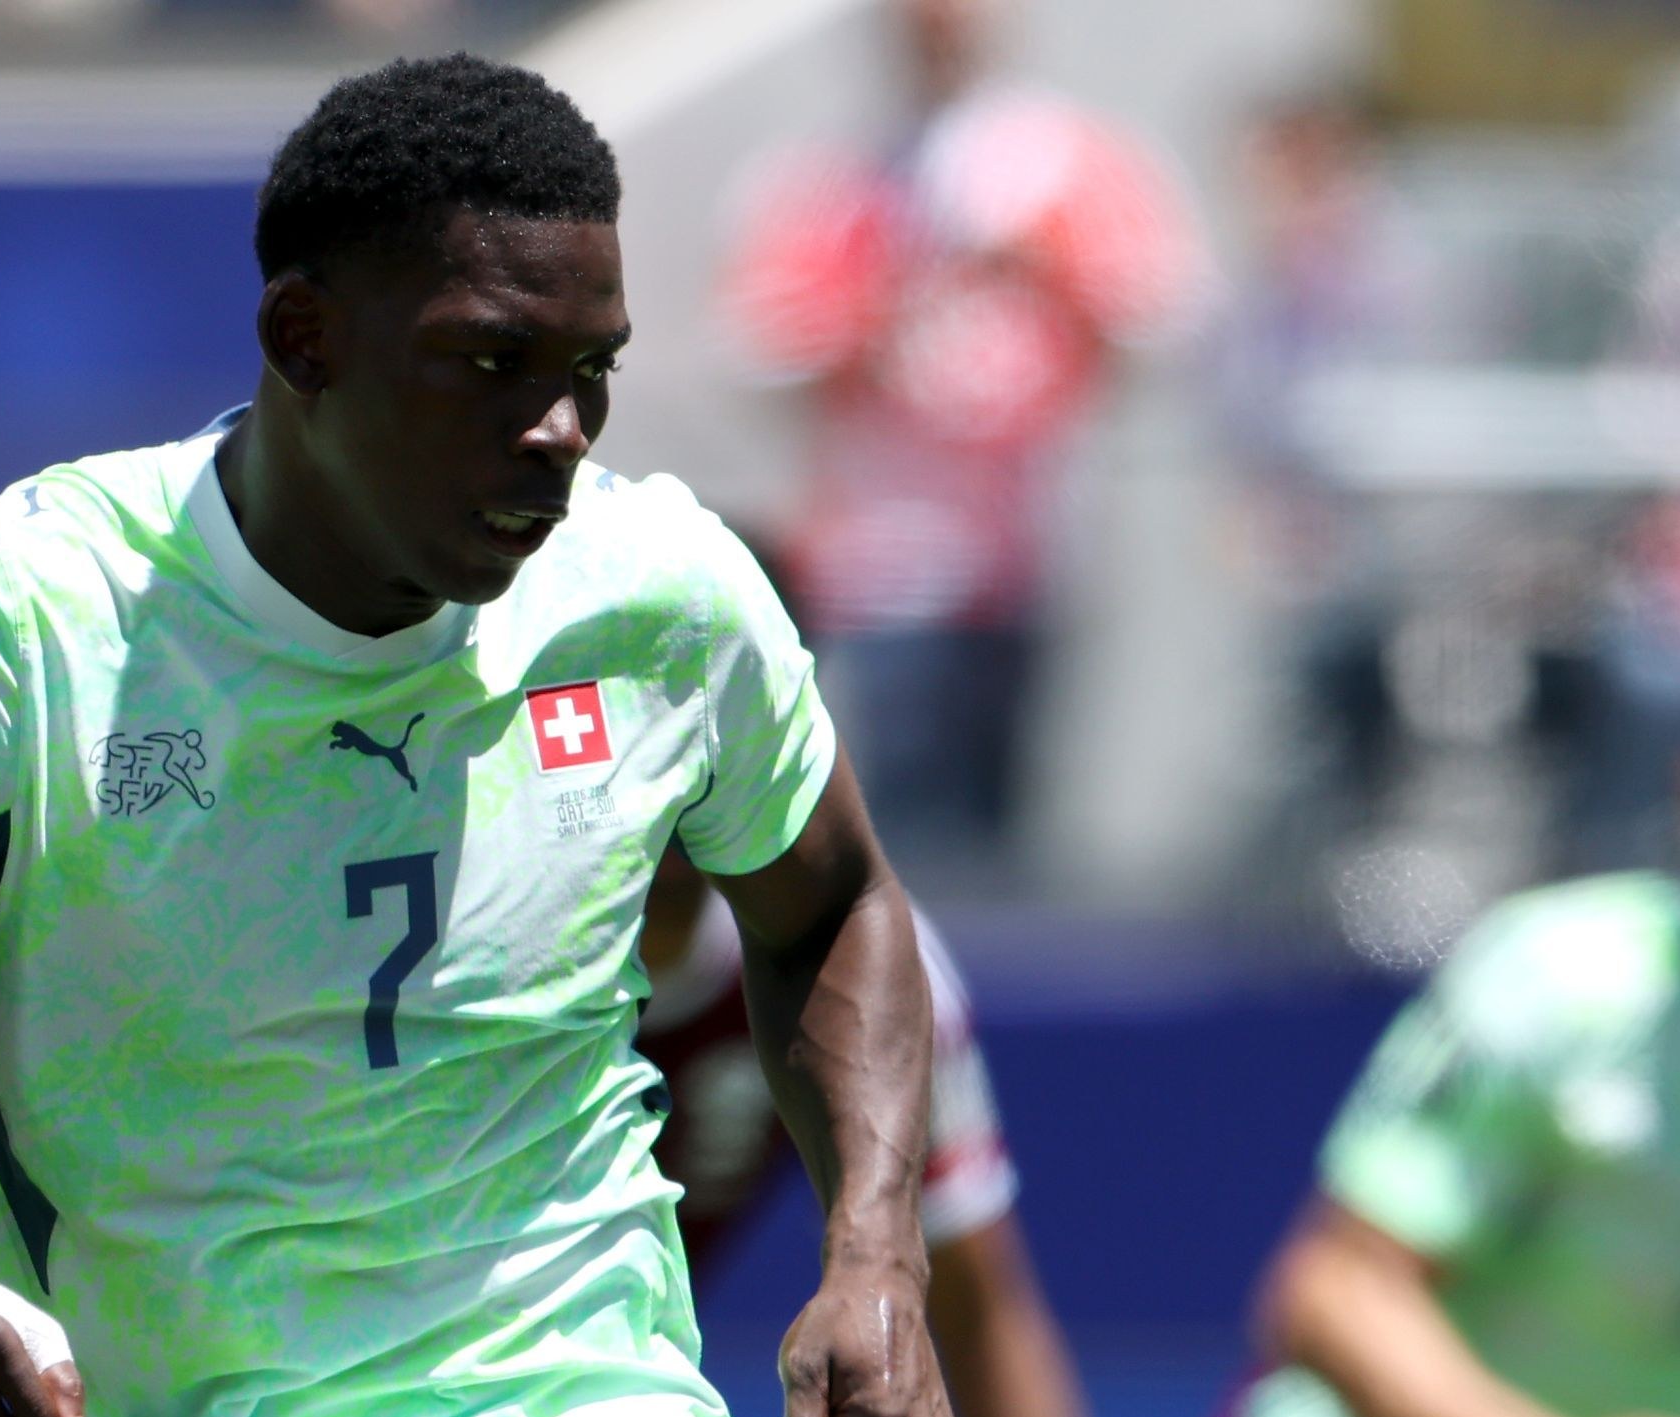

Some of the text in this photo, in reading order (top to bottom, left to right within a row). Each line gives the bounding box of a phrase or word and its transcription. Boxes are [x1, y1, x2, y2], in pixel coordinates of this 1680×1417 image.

[557, 802, 584, 823] QAT
[597, 795, 616, 815] SUI
[344, 851, 440, 1070] 7
